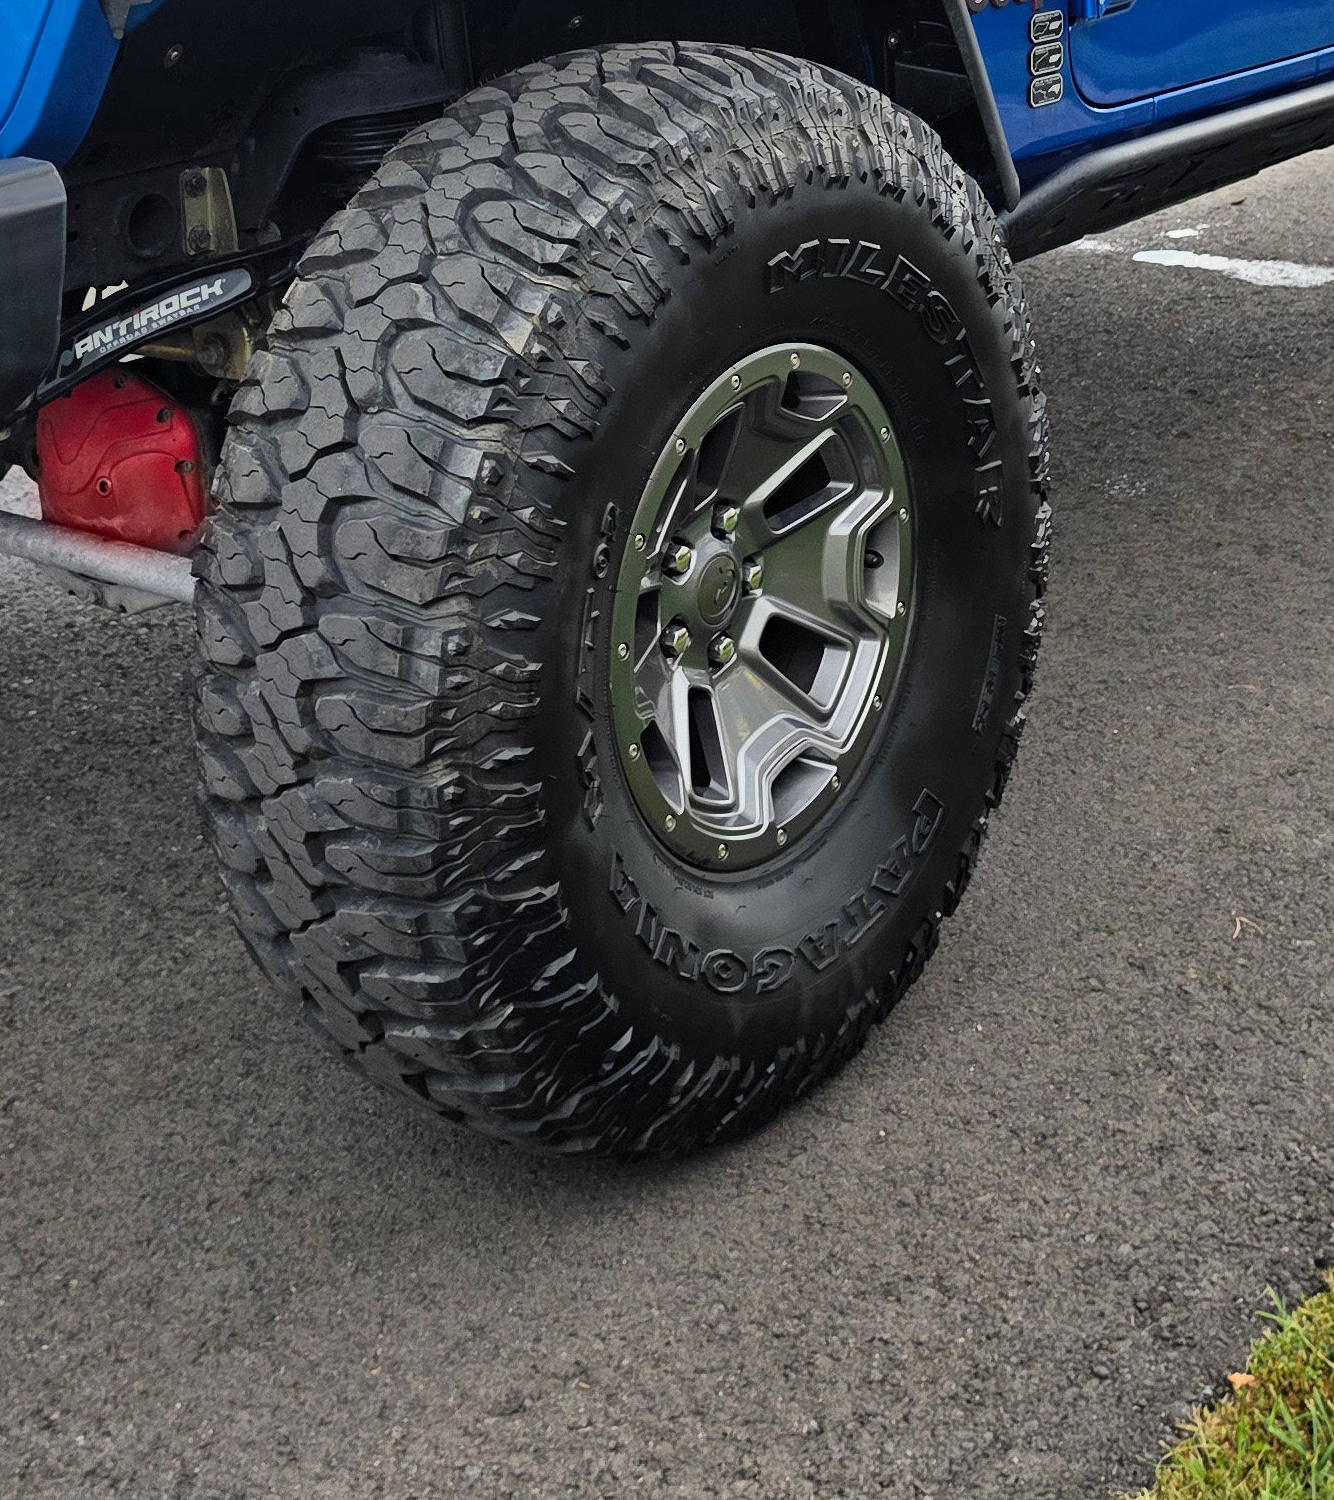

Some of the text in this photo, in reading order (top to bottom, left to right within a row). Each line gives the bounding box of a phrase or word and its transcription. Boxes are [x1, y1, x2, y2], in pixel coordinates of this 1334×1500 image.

[98, 326, 148, 354] OFFROAD
[766, 238, 1003, 528] MILESTAR
[610, 787, 944, 994] PATAGONIA
